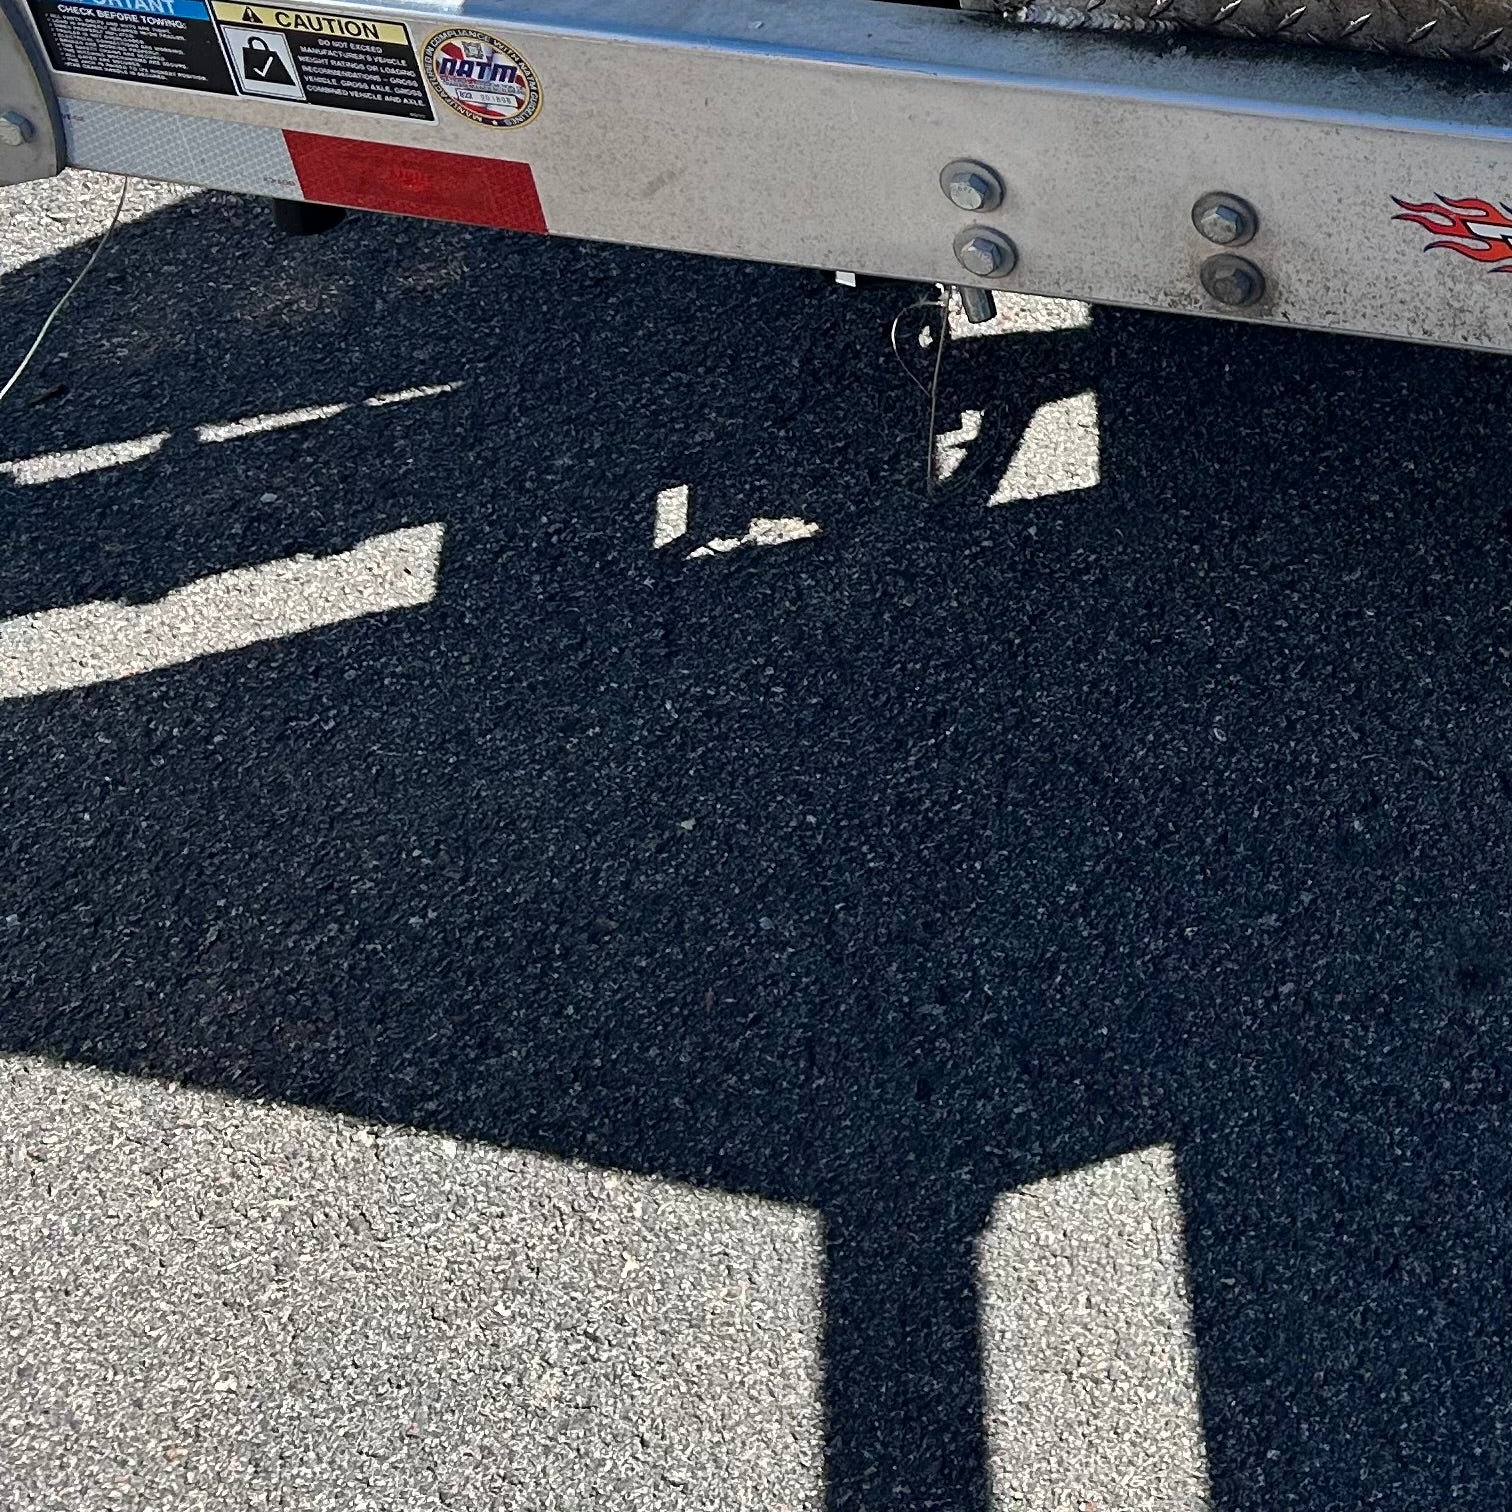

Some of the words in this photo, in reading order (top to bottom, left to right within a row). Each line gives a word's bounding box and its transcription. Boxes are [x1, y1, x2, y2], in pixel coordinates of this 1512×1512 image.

[57, 4, 95, 17] CHECK
[96, 9, 141, 23] BEFORE
[275, 11, 380, 40] CAUTION
[431, 29, 490, 49] COMPLIANCE
[493, 39, 519, 62] WITH
